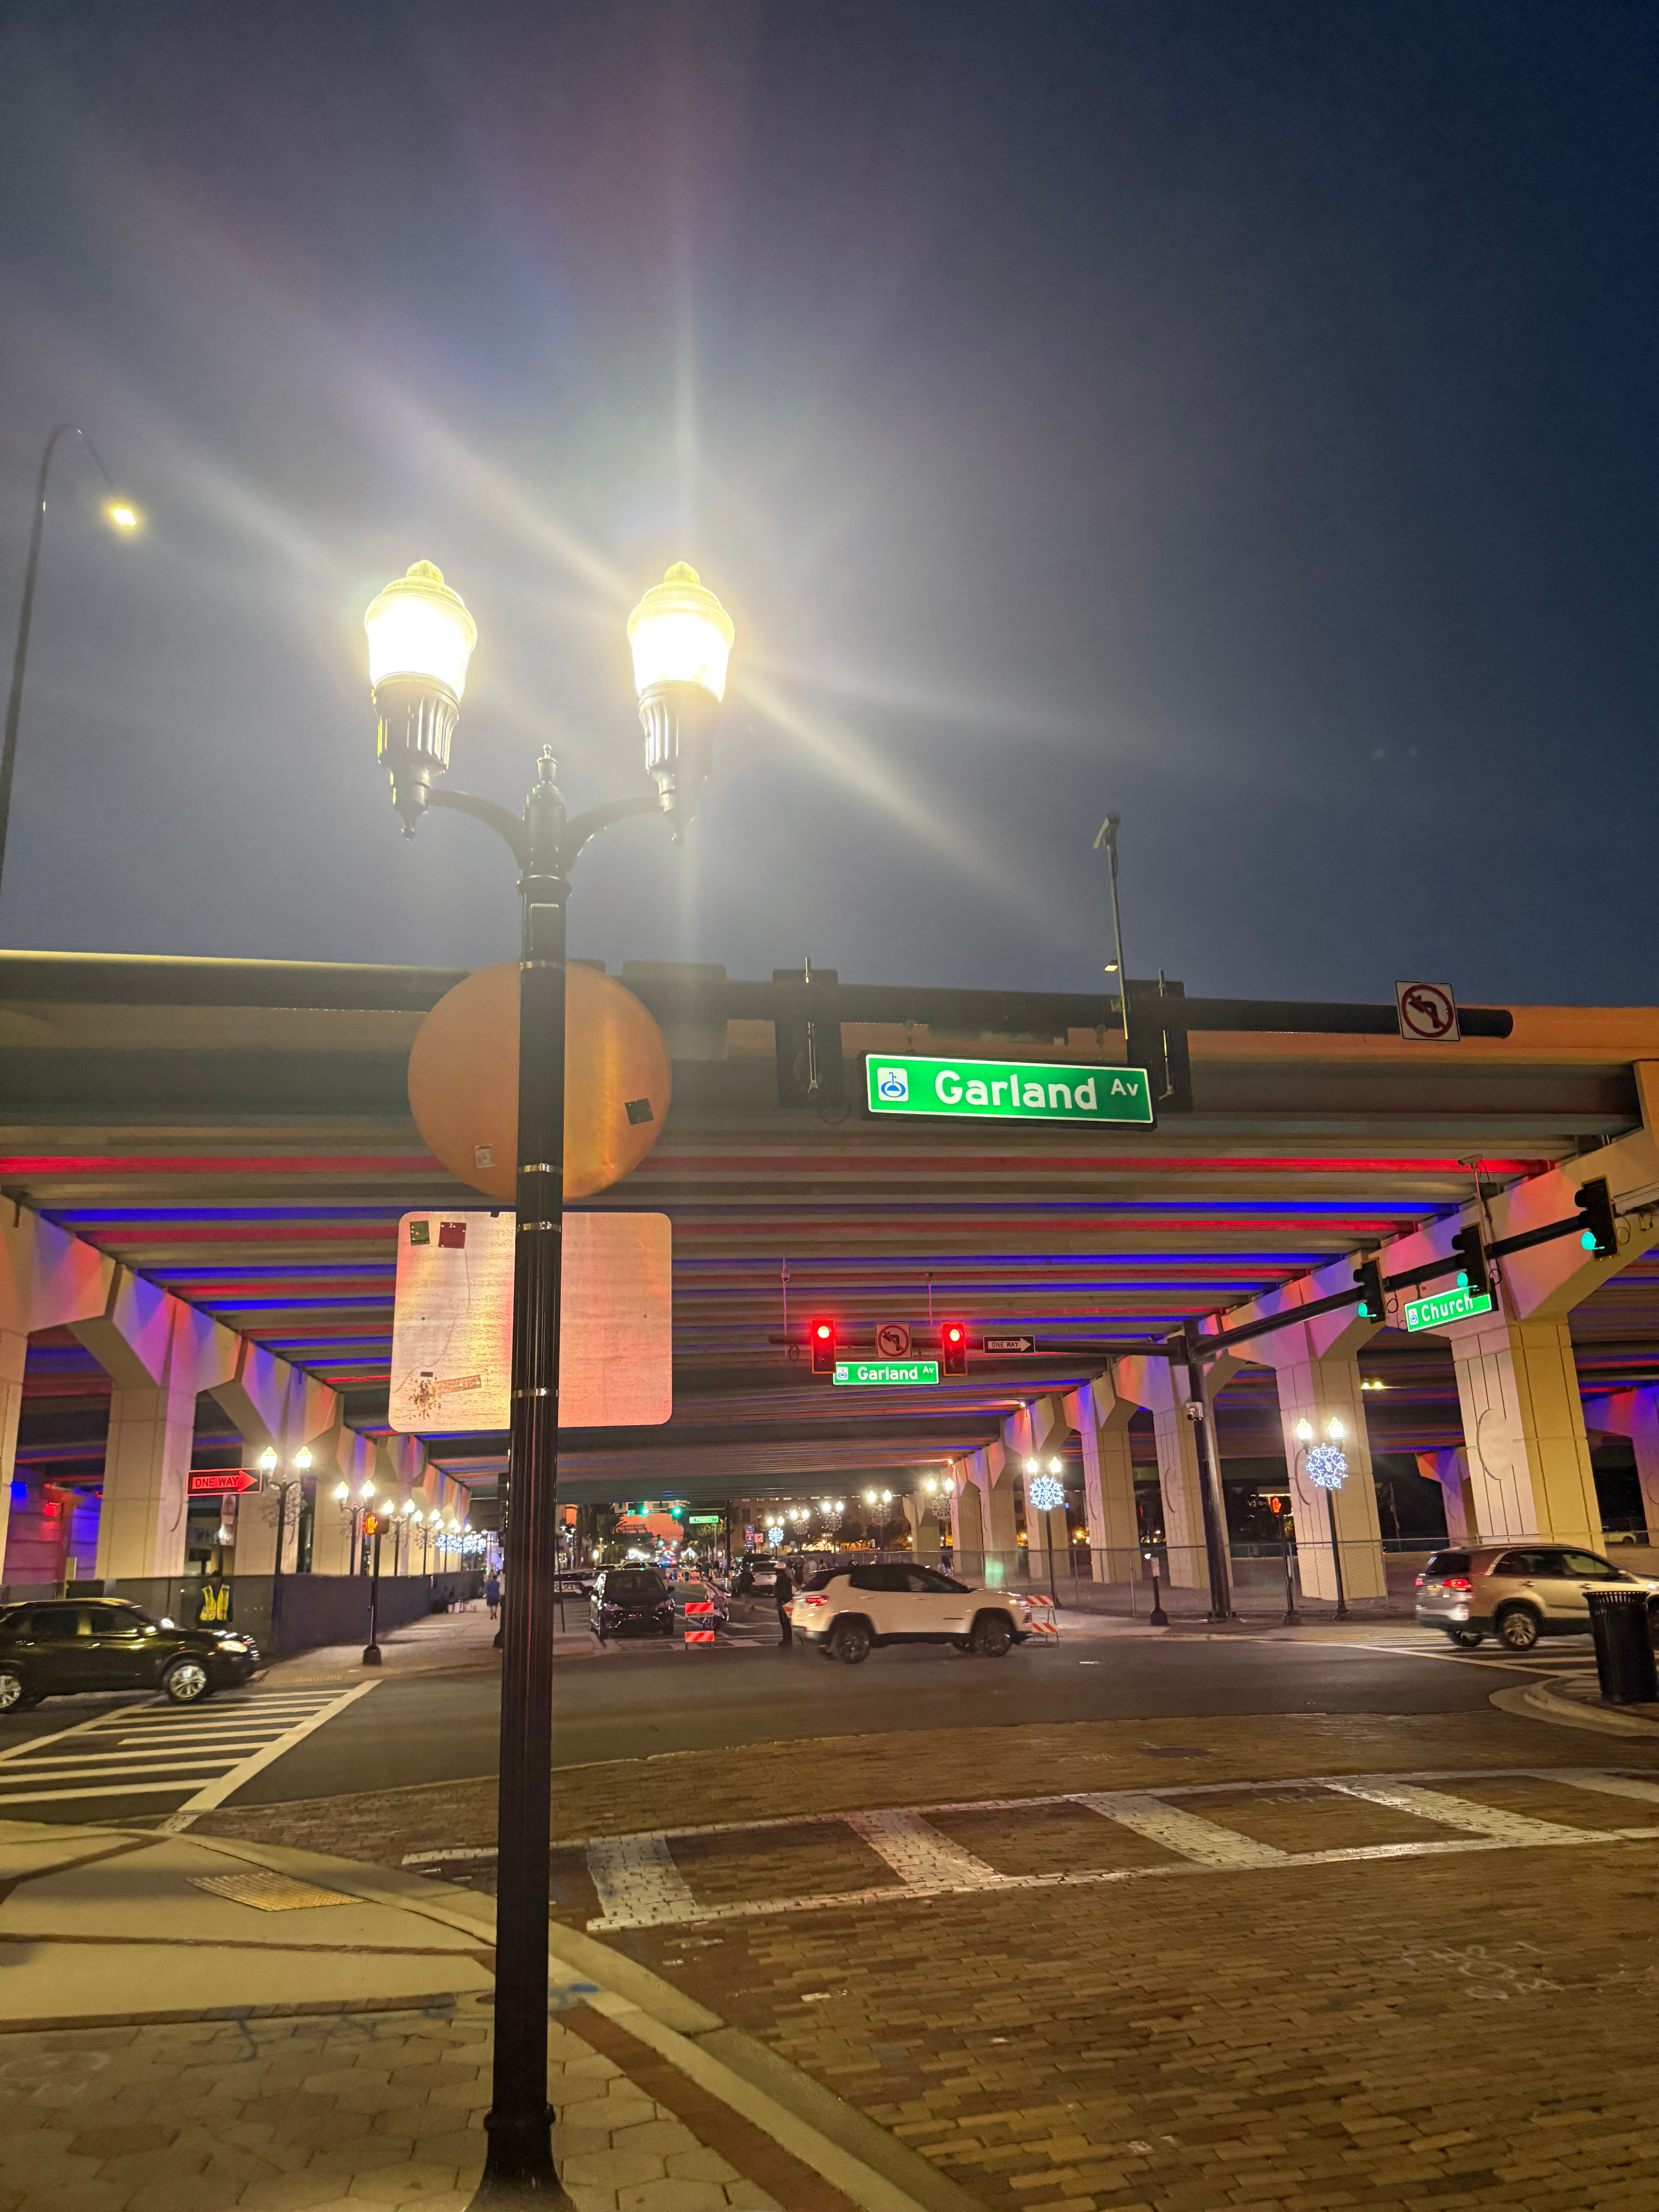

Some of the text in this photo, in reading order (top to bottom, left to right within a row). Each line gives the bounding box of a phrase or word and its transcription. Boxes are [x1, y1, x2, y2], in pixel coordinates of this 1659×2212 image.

[935, 1070, 1139, 1110] Garland Av
[1421, 1293, 1474, 1322] Church
[857, 1366, 918, 1381] Garland
[195, 1477, 239, 1487] ONE WAY
